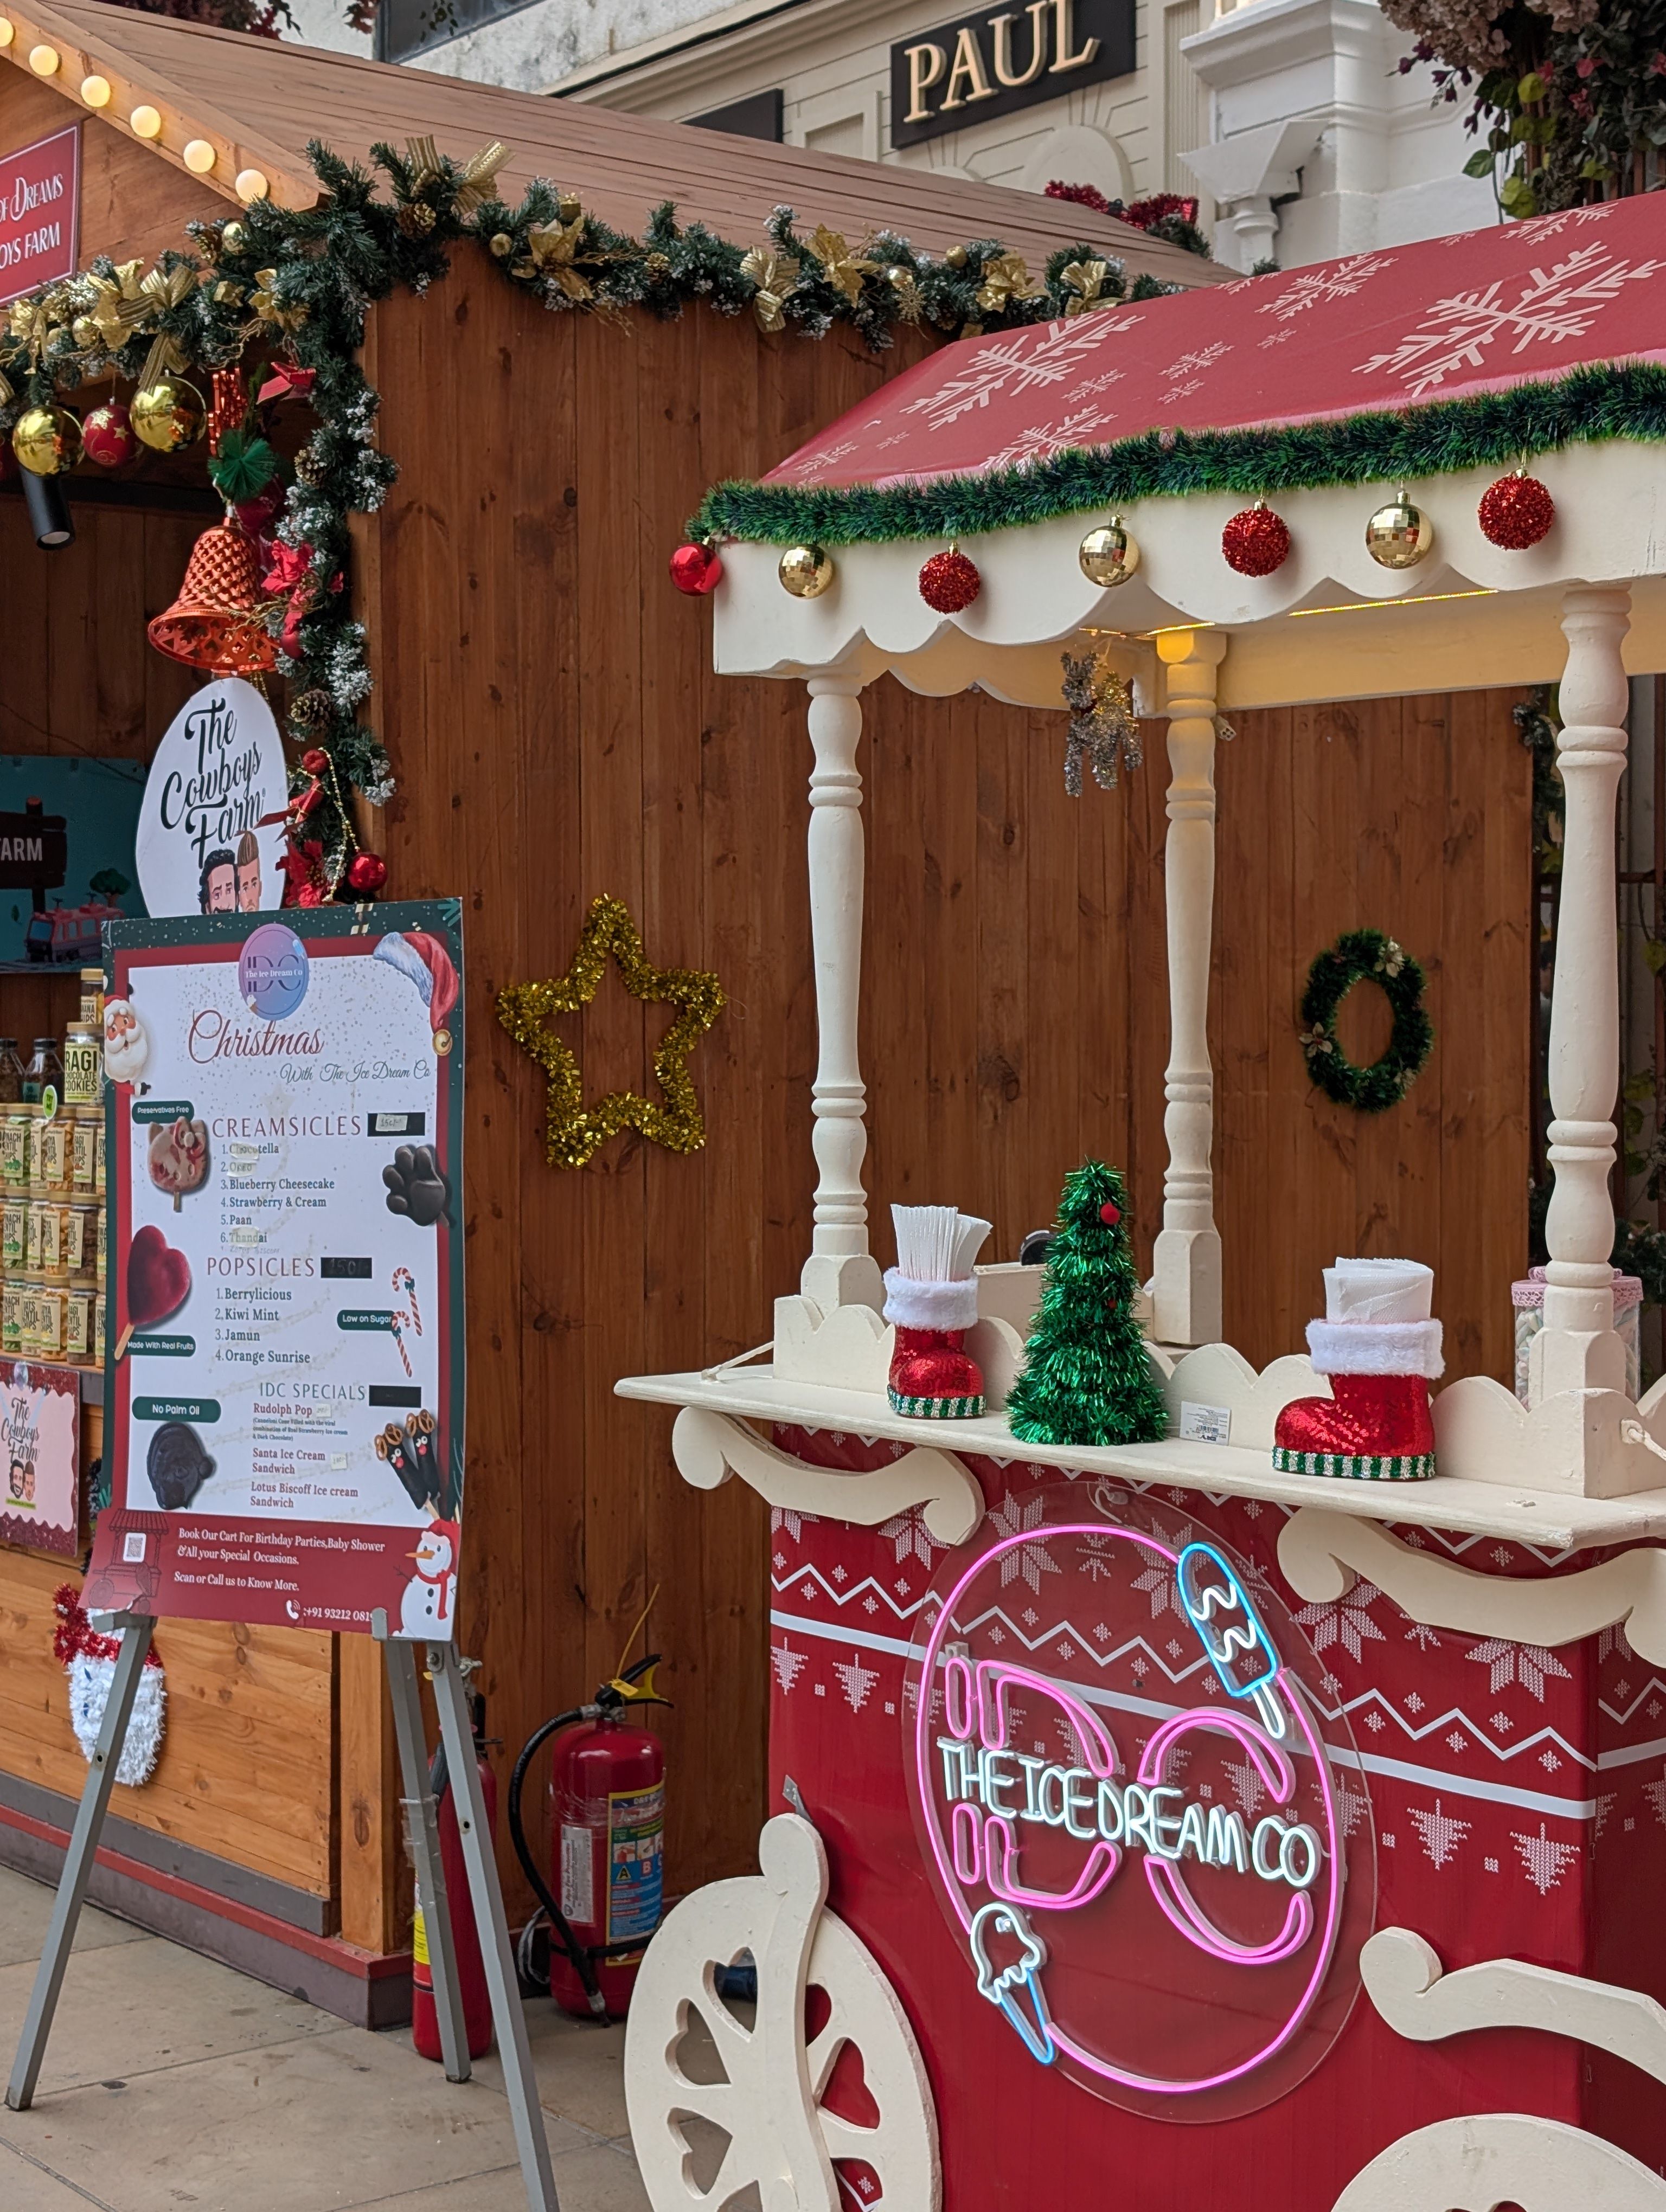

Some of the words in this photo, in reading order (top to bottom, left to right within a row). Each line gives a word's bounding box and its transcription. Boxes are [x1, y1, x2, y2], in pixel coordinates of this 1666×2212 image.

[904, 0, 1100, 123] PAUL
[25, 221, 60, 259] FARM
[184, 697, 238, 774] The
[161, 741, 262, 830] Cowboys
[0, 837, 43, 861] ARM
[246, 970, 258, 979] The
[259, 970, 269, 978] Ice
[188, 1009, 325, 1064] Christmas
[66, 1050, 97, 1072] RAGI
[280, 1063, 313, 1084] With
[319, 1063, 343, 1082] The
[345, 1060, 370, 1083] Ice
[371, 1061, 411, 1080] Dream
[413, 1059, 431, 1079] Co
[212, 1115, 362, 1138] CREAMSICLES
[229, 1179, 276, 1192] Blueberry
[279, 1178, 335, 1189] Cheesecake
[229, 1197, 283, 1211] Strawberry
[285, 1197, 293, 1207] &
[295, 1197, 326, 1207] Cream
[229, 1214, 252, 1225] Paan
[207, 1257, 315, 1277] POPSICLES
[225, 1287, 292, 1303] Berrylicious
[225, 1308, 249, 1320] Kiwi
[253, 1308, 280, 1321] Mint
[342, 1314, 358, 1322] Low
[370, 1315, 392, 1324] Sugar
[225, 1329, 260, 1341] Jamun
[127, 1341, 144, 1349] Made
[145, 1341, 161, 1349] With
[162, 1341, 175, 1349] Real
[176, 1342, 194, 1351] Fruits
[226, 1349, 265, 1365] Orange
[267, 1351, 311, 1364] Sunrise
[260, 1382, 286, 1398] IDC
[293, 1383, 366, 1400] SPECIALS
[11, 1397, 30, 1425] The
[152, 1404, 164, 1414] No
[165, 1404, 187, 1414] Palm
[189, 1405, 200, 1415] Oil
[253, 1403, 292, 1417] Rudolph
[295, 1404, 313, 1418] Pop
[1, 1417, 40, 1445] Cowboys
[8, 1437, 40, 1464] Farm
[253, 1448, 278, 1459] Santa
[281, 1449, 294, 1459] Ice
[297, 1449, 325, 1461] Cream
[252, 1462, 295, 1475] Sandwich
[251, 1481, 277, 1493] Lotus
[279, 1483, 312, 1494] Biscoff
[313, 1484, 328, 1495] Ice
[330, 1488, 358, 1497] cream
[250, 1495, 294, 1508] Sandwich
[179, 1527, 200, 1540] Book
[201, 1529, 218, 1541] Our
[219, 1530, 238, 1542] Cart
[239, 1532, 254, 1543] For
[255, 1532, 293, 1548] Birthday
[351, 1538, 386, 1552] Shower
[198, 1548, 219, 1561] your
[220, 1548, 251, 1562] Special
[174, 1571, 195, 1583] Scan
[196, 1574, 207, 1584] or
[207, 1573, 225, 1585] Call
[225, 1577, 236, 1586] us
[237, 1576, 246, 1586] to
[247, 1576, 273, 1589] Know
[324, 1608, 351, 1621] 93212
[937, 1736, 1018, 1819] THE
[1018, 1755, 1097, 1838] ICE
[1098, 1779, 1248, 1874] DREAM
[1252, 1815, 1323, 1888] CO
